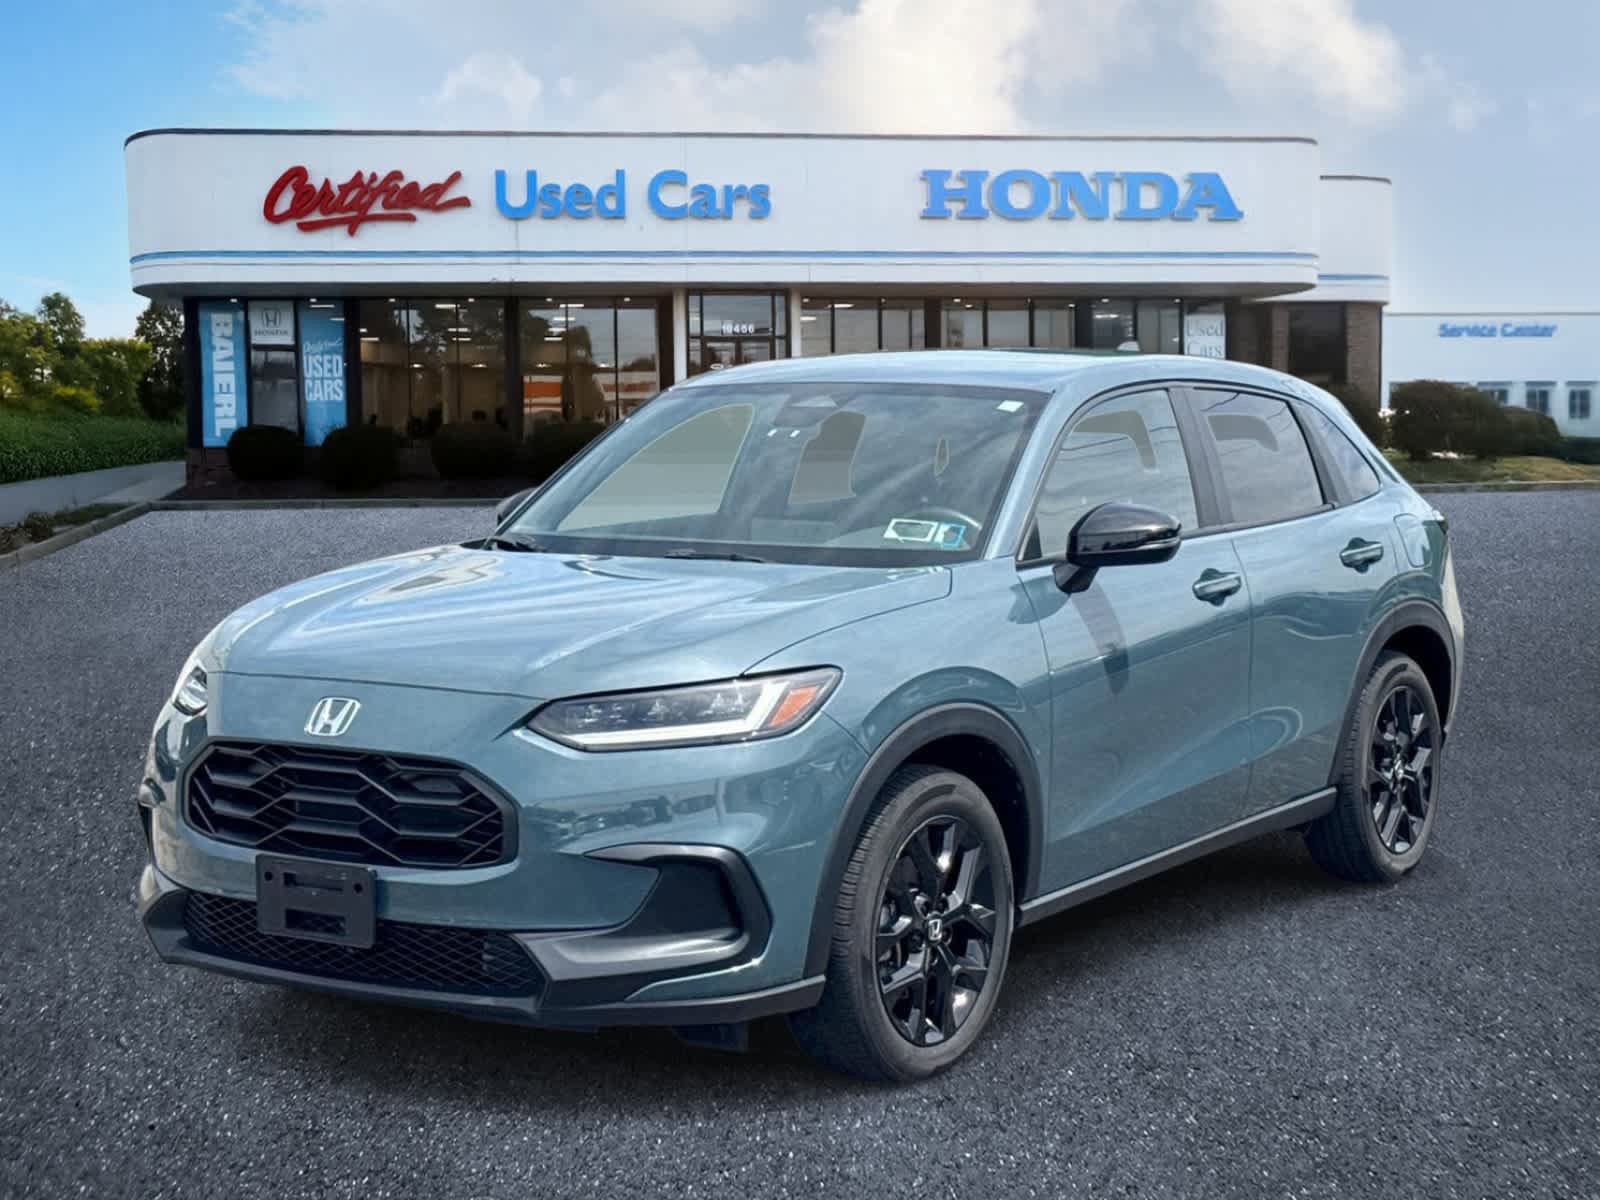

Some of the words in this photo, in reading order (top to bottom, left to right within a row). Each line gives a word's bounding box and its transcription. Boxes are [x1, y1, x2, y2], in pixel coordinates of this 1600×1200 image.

[263, 165, 471, 236] Certified
[495, 168, 626, 219] Used
[648, 170, 771, 219] Cars
[920, 168, 1244, 221] HONDA
[1186, 319, 1225, 337] Used
[1438, 322, 1497, 338] Service
[1500, 322, 1558, 338] Center
[211, 313, 238, 437] BAIERL
[303, 354, 343, 378] USED
[304, 378, 344, 401] CARS
